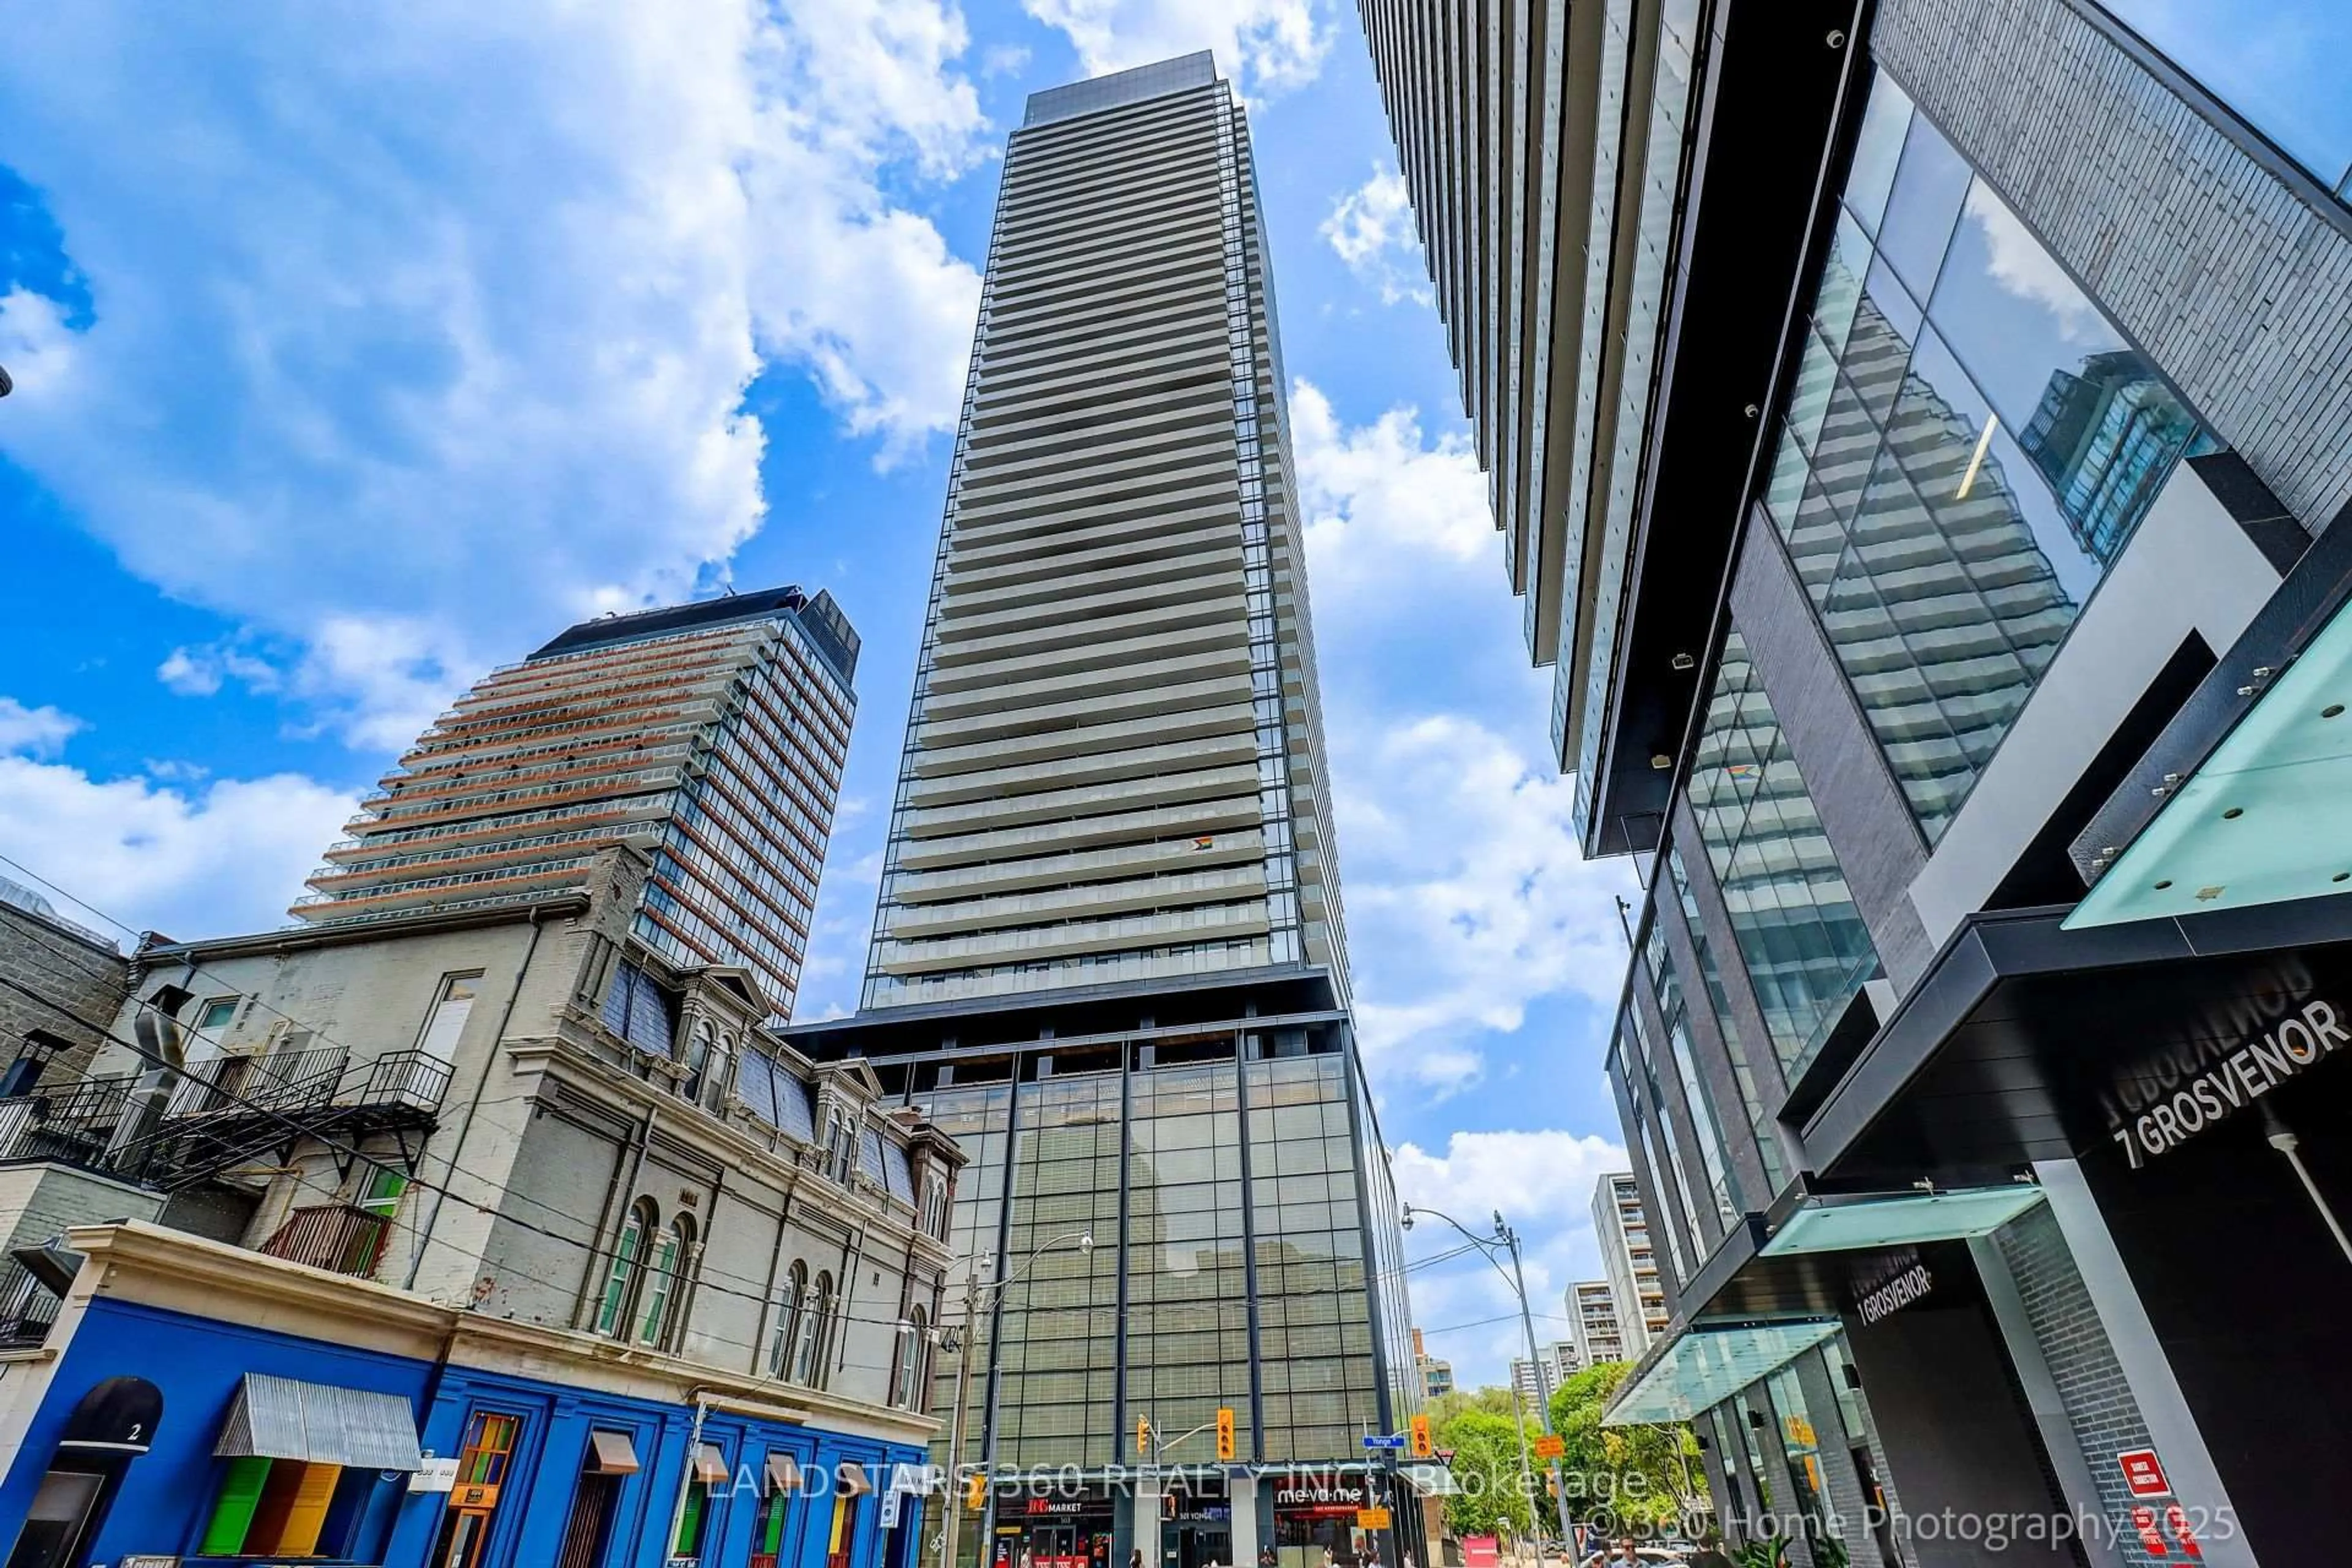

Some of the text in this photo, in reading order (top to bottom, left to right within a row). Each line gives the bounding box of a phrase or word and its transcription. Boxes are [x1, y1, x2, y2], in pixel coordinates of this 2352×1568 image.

[2114, 1000, 2351, 1169] 7 GROSVENOR
[1863, 1264, 1932, 1323] GROSVENOR
[127, 1423, 142, 1441] 2
[1048, 1502, 1082, 1513] MARKET
